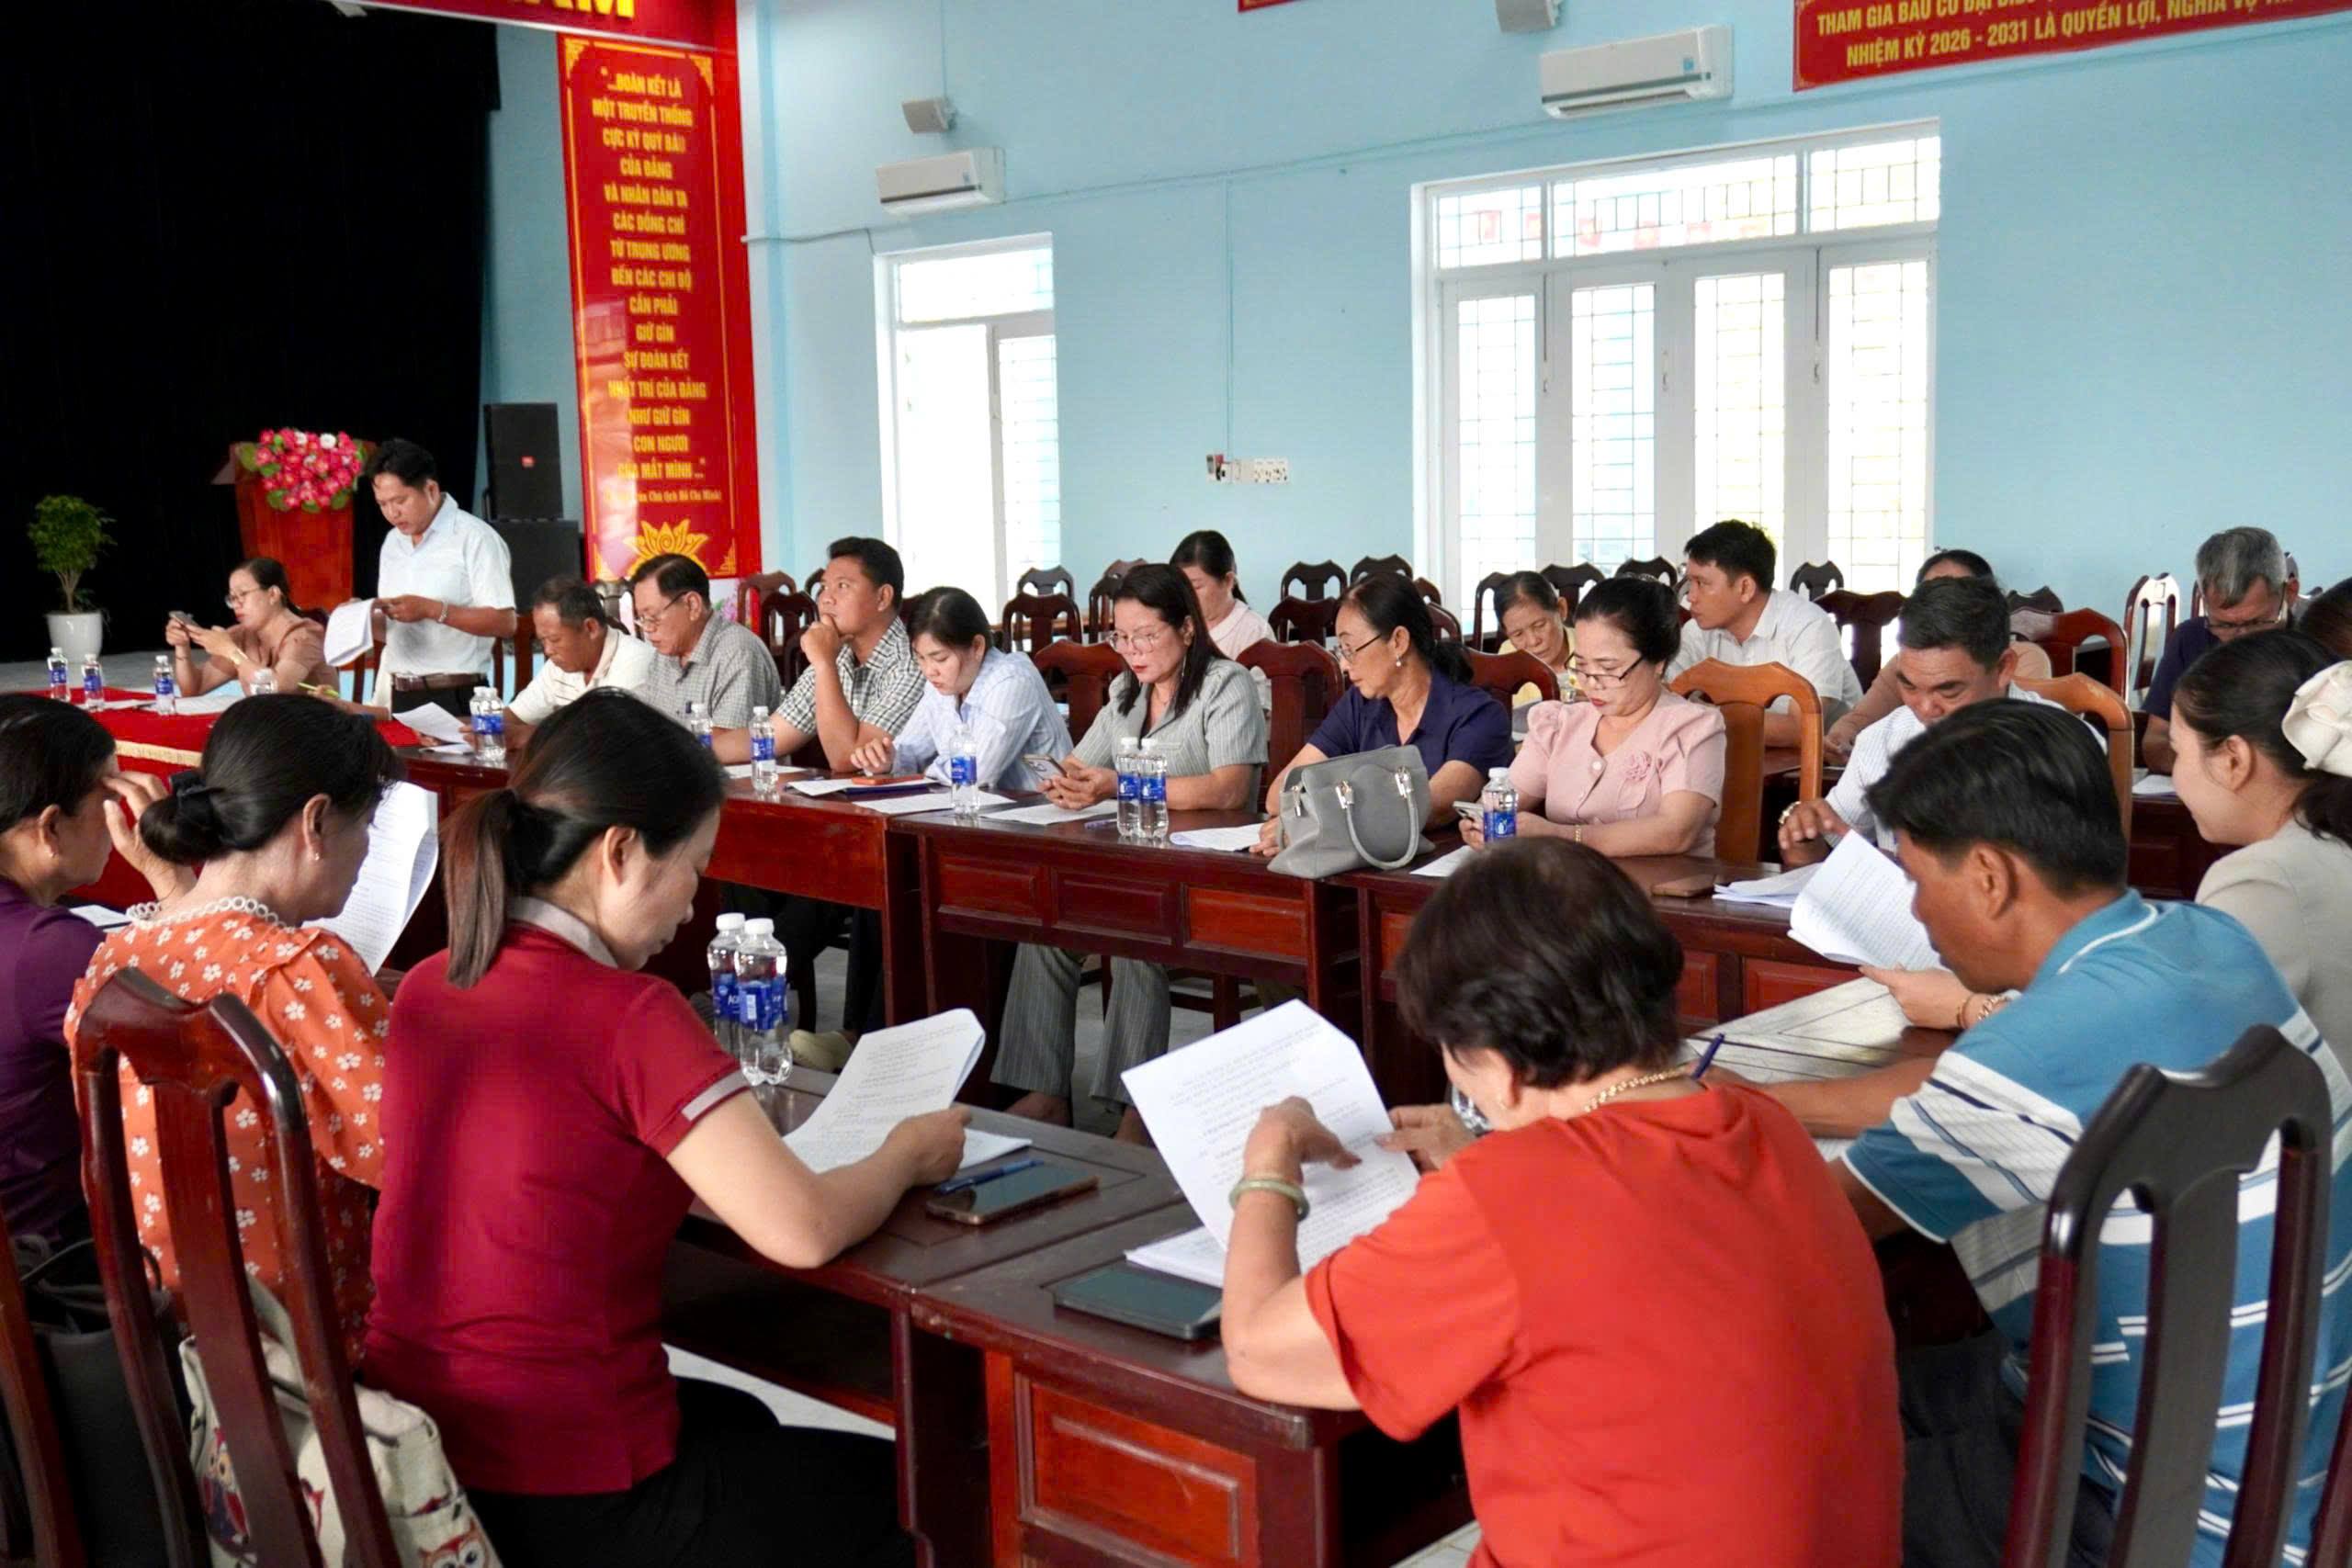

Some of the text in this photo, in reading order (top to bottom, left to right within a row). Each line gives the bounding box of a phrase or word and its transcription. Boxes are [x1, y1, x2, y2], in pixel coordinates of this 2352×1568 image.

[1817, 8, 1862, 36] THAM
[1866, 4, 1894, 28] GIA
[1847, 37, 1899, 68] NHIỆM
[1929, 28, 1971, 56] 2026
[1987, 19, 2027, 46] 2031
[2034, 11, 2055, 39] LÀ
[2061, 1, 2120, 37] QUYỀN
[647, 73, 666, 96] KẾT
[668, 77, 683, 98] LÀ
[592, 96, 693, 127] MỘT TRUYỀN THỐNG
[603, 128, 625, 150] CỰC
[619, 152, 673, 179] CỦA ĐẢNG
[604, 182, 618, 202] VÀ
[620, 184, 650, 205] NHÂN
[652, 186, 674, 206] DÂN
[613, 209, 685, 235] CÁC ĐỒNG CHÍ
[610, 237, 625, 258] TỪ
[627, 241, 661, 260] TRUNG
[611, 264, 692, 292] ĐẾN CÁC CHI BỘ
[629, 292, 678, 315] CẦN PHẢI
[636, 321, 675, 342] GIỮ GÌN
[623, 347, 689, 372] SỰ ĐOÀN KẾT
[637, 378, 654, 397] TRÍ
[656, 377, 677, 398] CỦA
[678, 377, 707, 398] ĐẢNG
[652, 406, 671, 425] GIỮ
[672, 406, 691, 425] GÌN
[633, 435, 655, 452] CON
